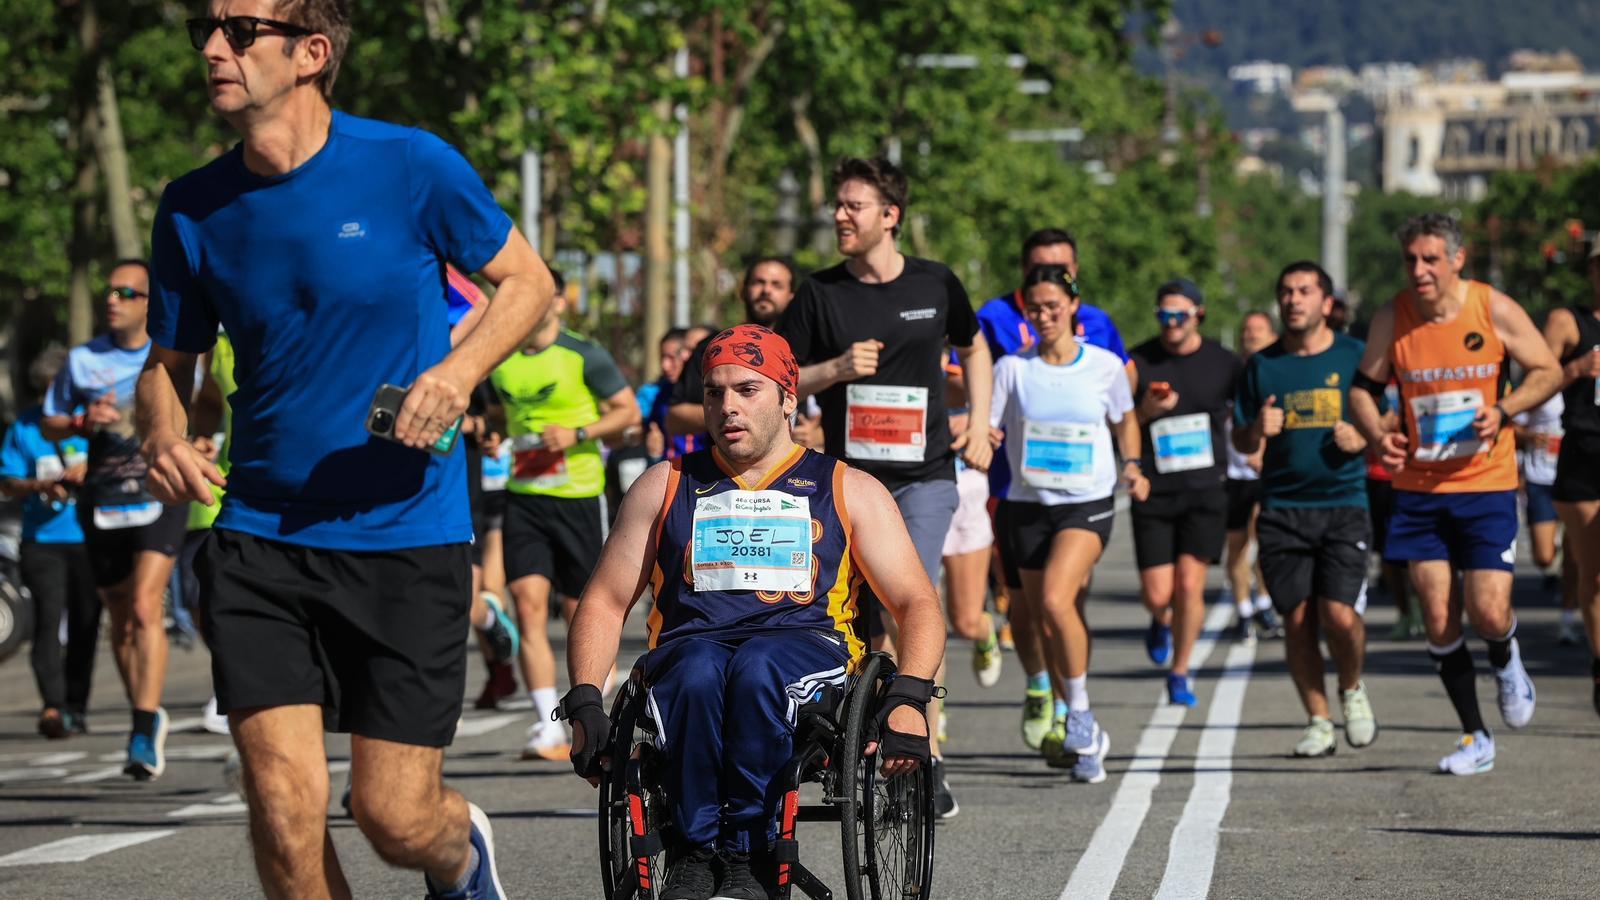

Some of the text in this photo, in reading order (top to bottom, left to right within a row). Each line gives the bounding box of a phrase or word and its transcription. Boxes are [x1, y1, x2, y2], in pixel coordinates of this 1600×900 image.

[787, 478, 815, 487] Rakuten
[716, 529, 795, 545] JOEL
[731, 546, 771, 557] 20381
